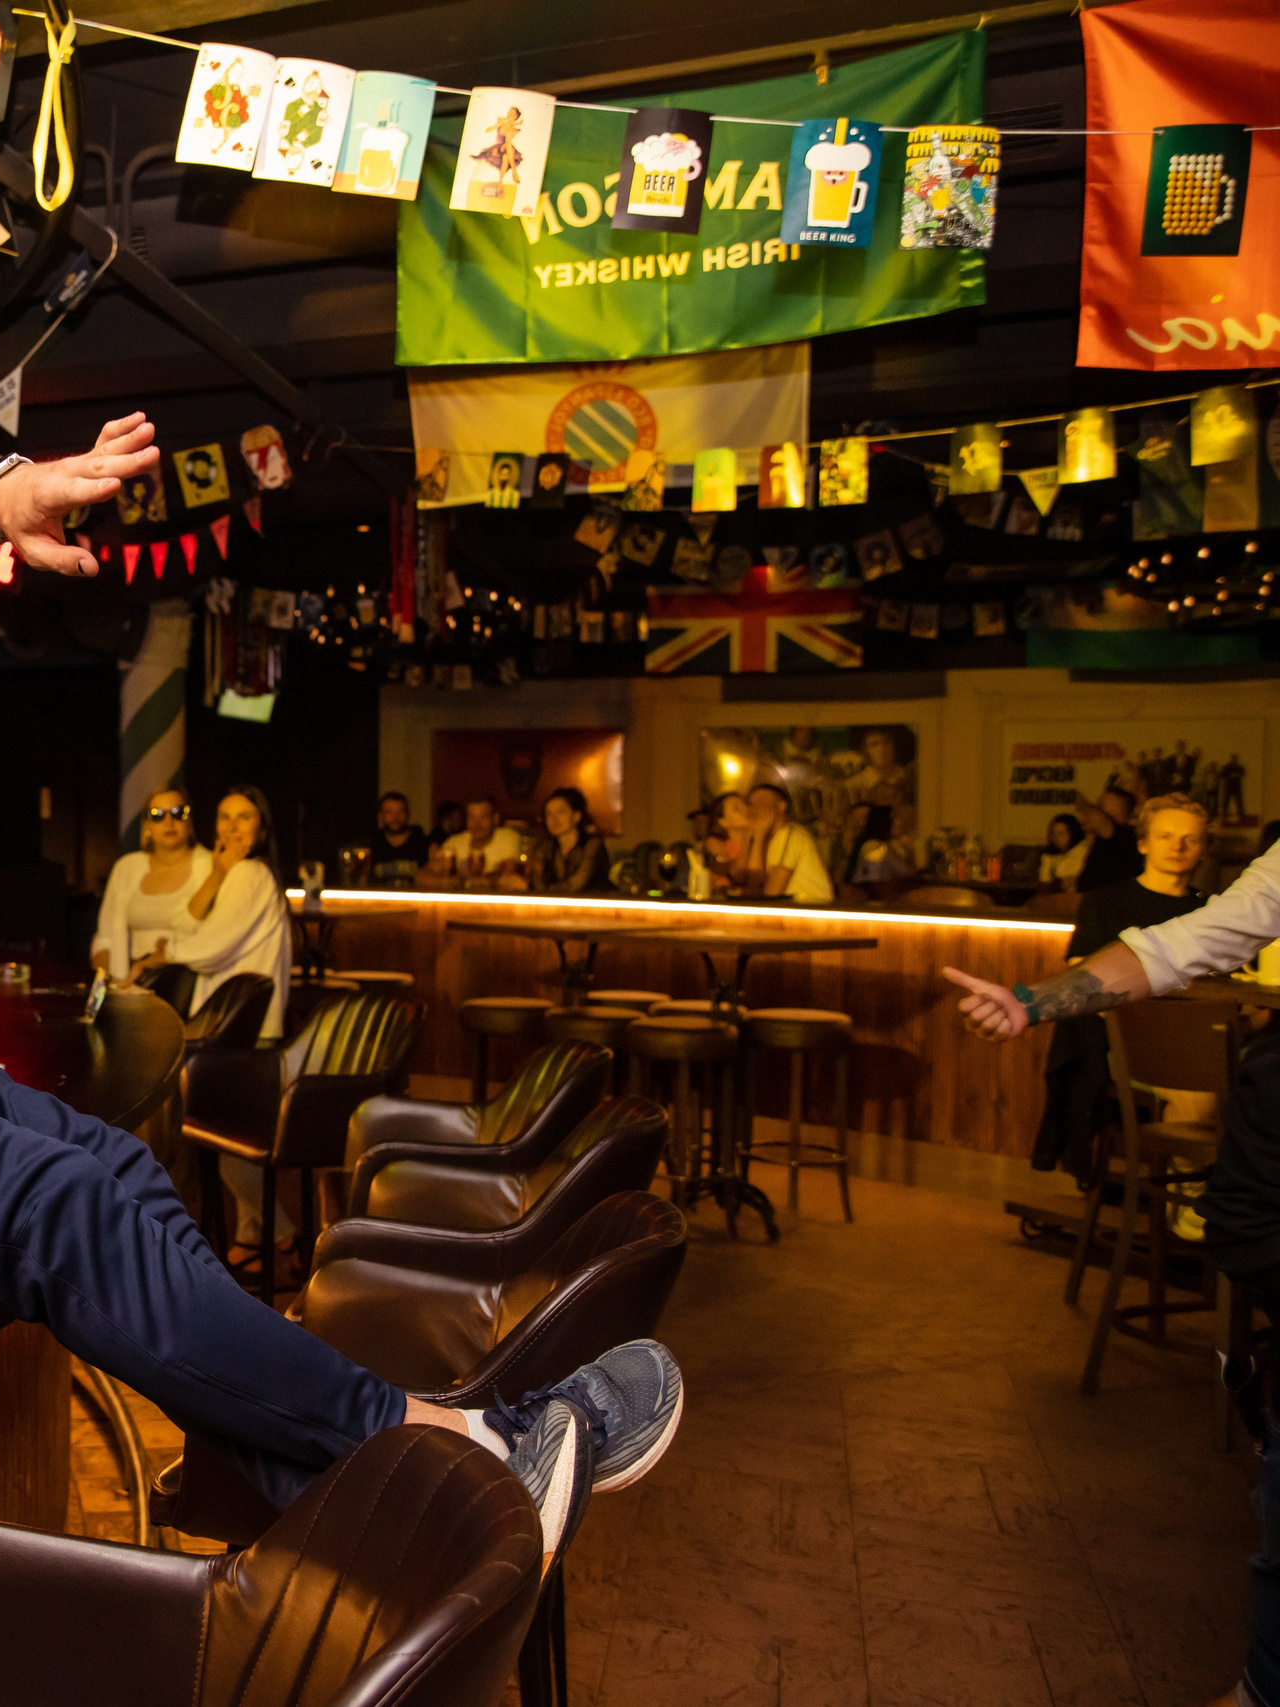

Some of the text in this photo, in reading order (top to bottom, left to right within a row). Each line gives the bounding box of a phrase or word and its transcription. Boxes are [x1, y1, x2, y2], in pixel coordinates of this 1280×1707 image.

[644, 174, 676, 192] BEER
[799, 230, 857, 244] BEER KING
